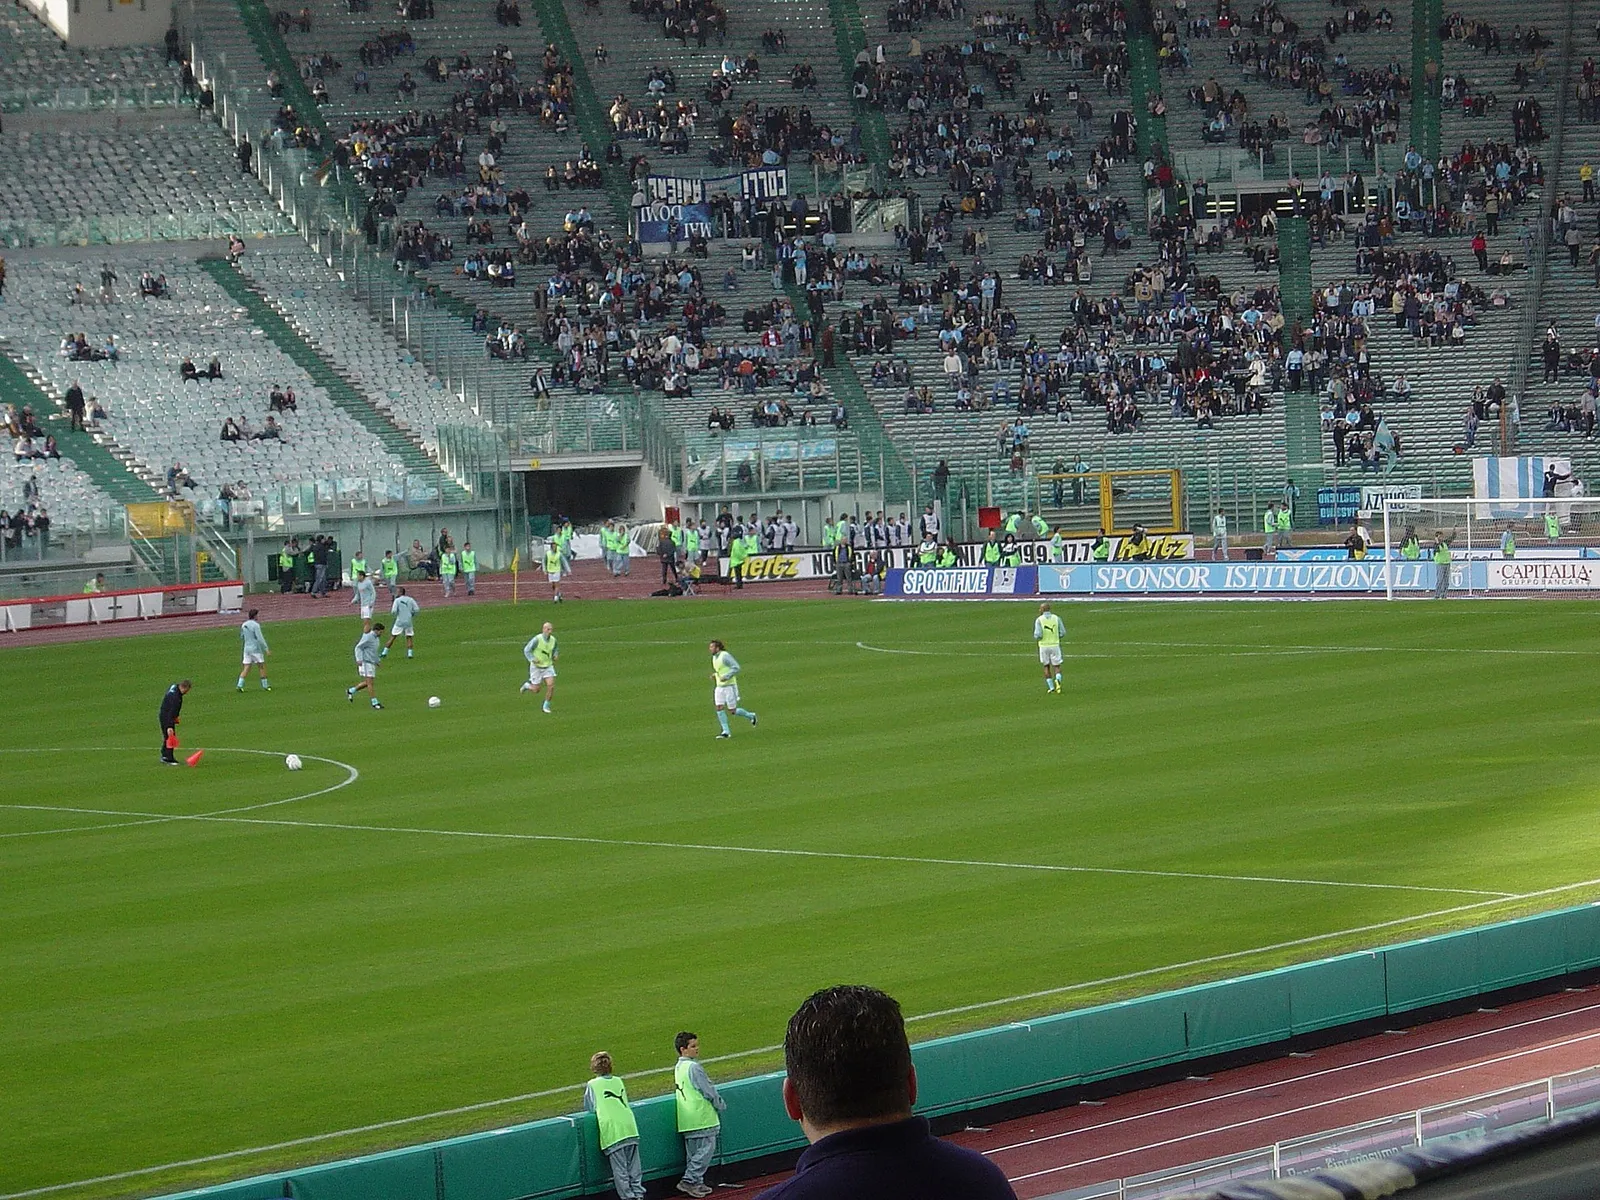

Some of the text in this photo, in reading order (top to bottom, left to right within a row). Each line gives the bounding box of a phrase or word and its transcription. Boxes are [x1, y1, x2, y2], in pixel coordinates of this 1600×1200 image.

[903, 568, 989, 594] SPORTFIVE
[1095, 564, 1424, 589] SPONSOR ISTITUZIONALI
[1501, 564, 1590, 579] CAPITALIA
[1502, 578, 1539, 586] GRUPPO
